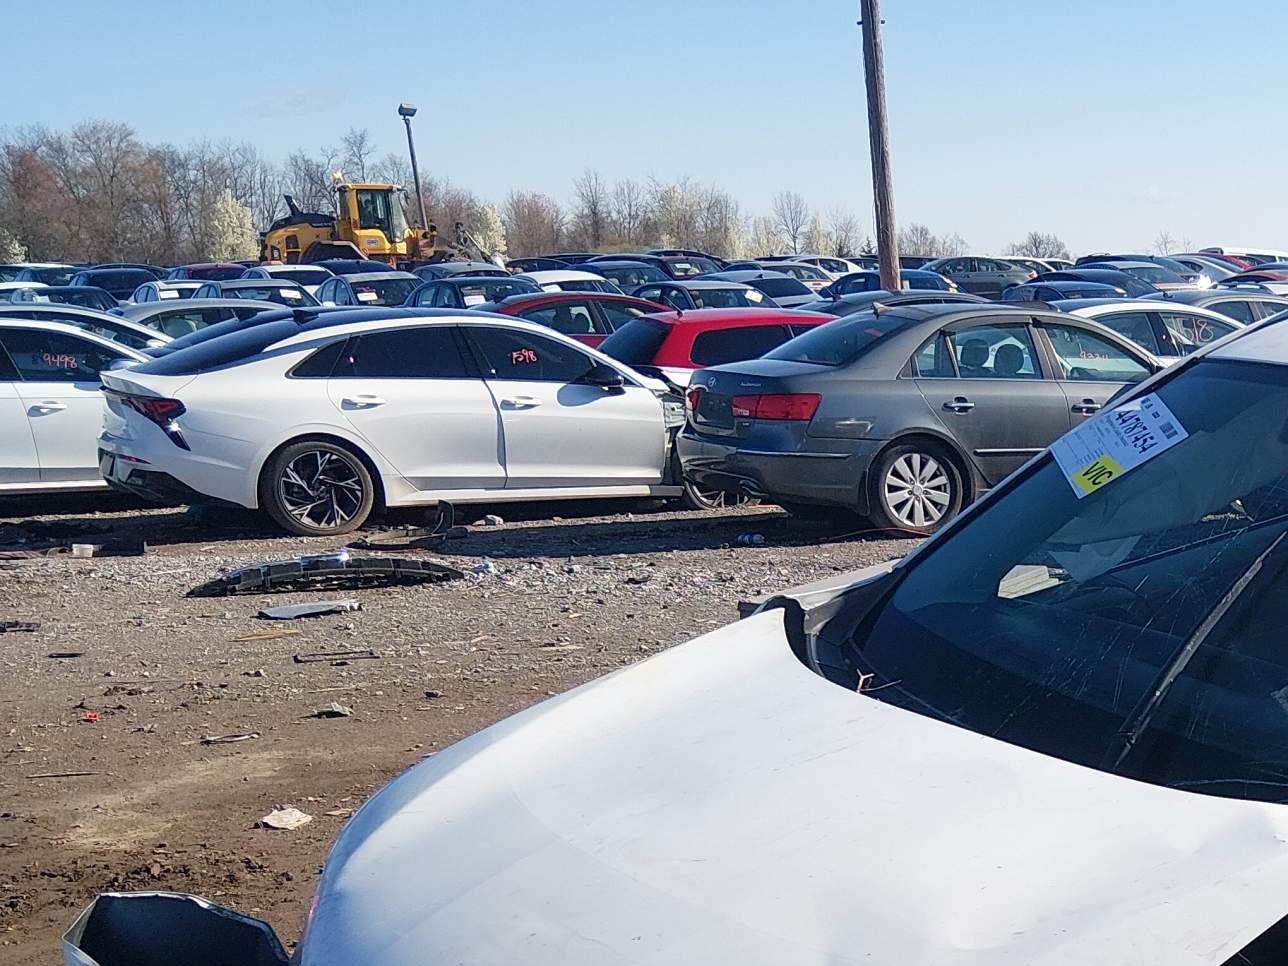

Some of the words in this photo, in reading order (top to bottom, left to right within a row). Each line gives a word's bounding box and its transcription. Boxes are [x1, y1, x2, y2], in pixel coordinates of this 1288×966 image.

[42, 352, 78, 369] 9498
[1115, 409, 1158, 454] 44787454
[1082, 461, 1113, 486] VIC
